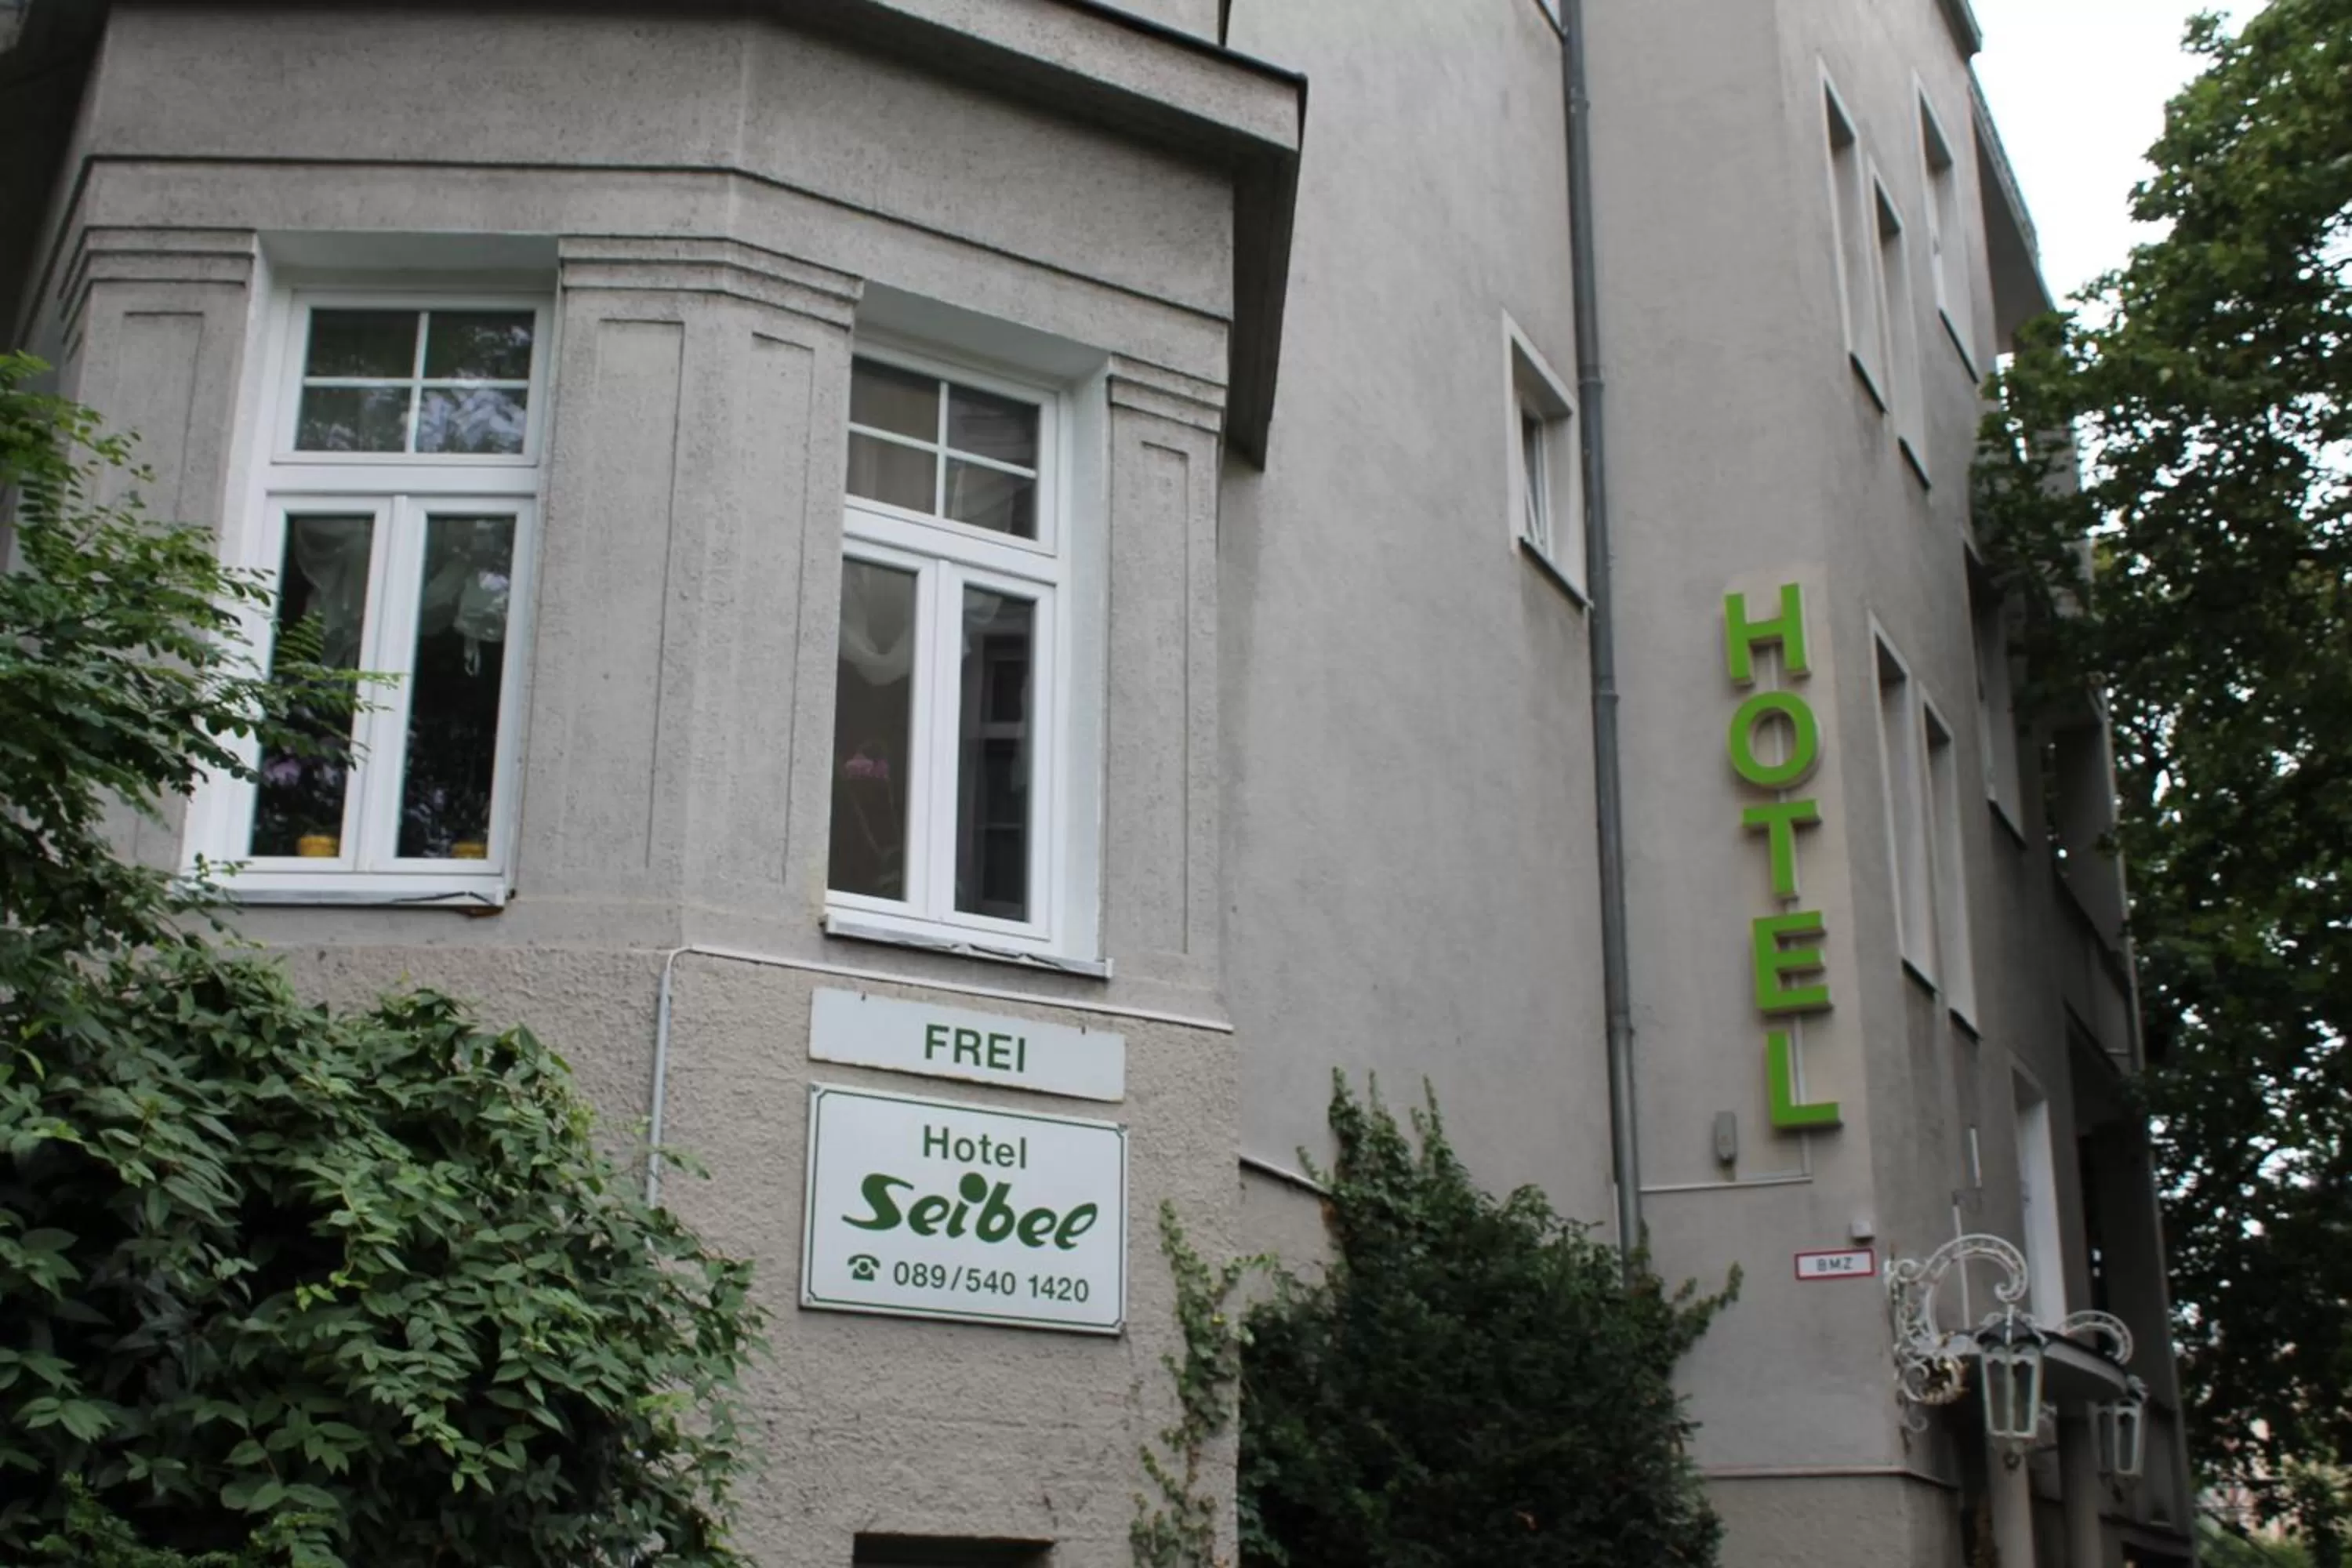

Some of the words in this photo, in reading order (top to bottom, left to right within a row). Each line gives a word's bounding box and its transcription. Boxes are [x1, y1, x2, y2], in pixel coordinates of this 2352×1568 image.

[1725, 583, 1840, 1127] HOTEL
[925, 1024, 1025, 1073] FREI
[923, 1125, 1026, 1169] Hotel
[893, 1261, 1016, 1296] 089/540
[1028, 1275, 1090, 1303] 1420
[1817, 1256, 1853, 1272] BMZ
